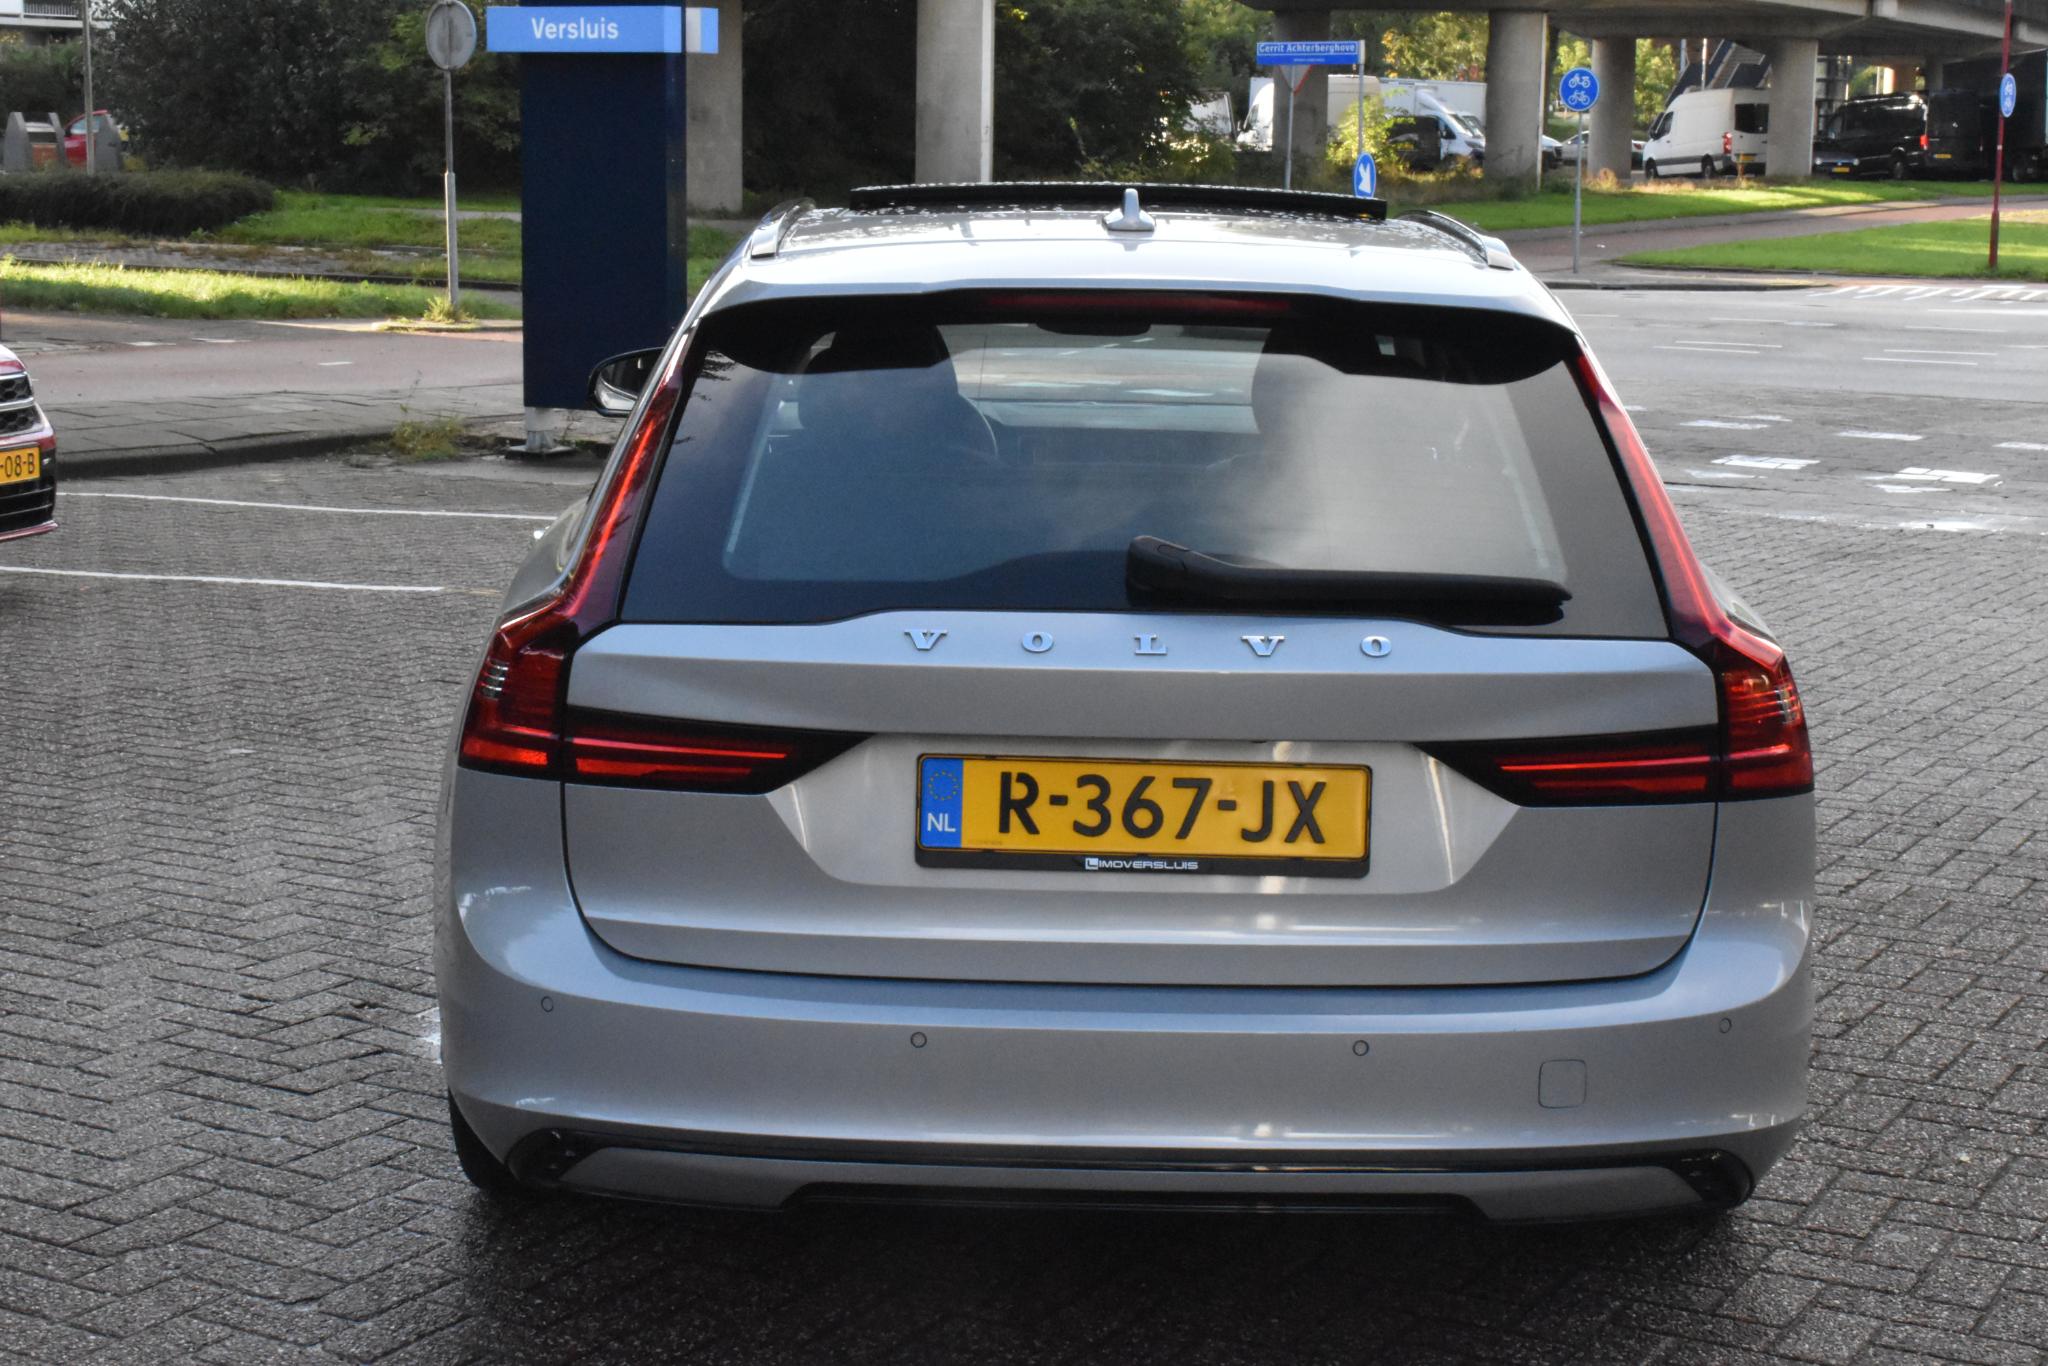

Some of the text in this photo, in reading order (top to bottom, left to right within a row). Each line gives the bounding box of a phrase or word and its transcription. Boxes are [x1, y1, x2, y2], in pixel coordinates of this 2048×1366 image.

[532, 17, 619, 39] Versluis
[1259, 44, 1355, 54] Gerrit Achterberghove
[904, 630, 1392, 656] VOLVO
[999, 771, 1326, 844] R-367-JX
[927, 812, 956, 833] NL
